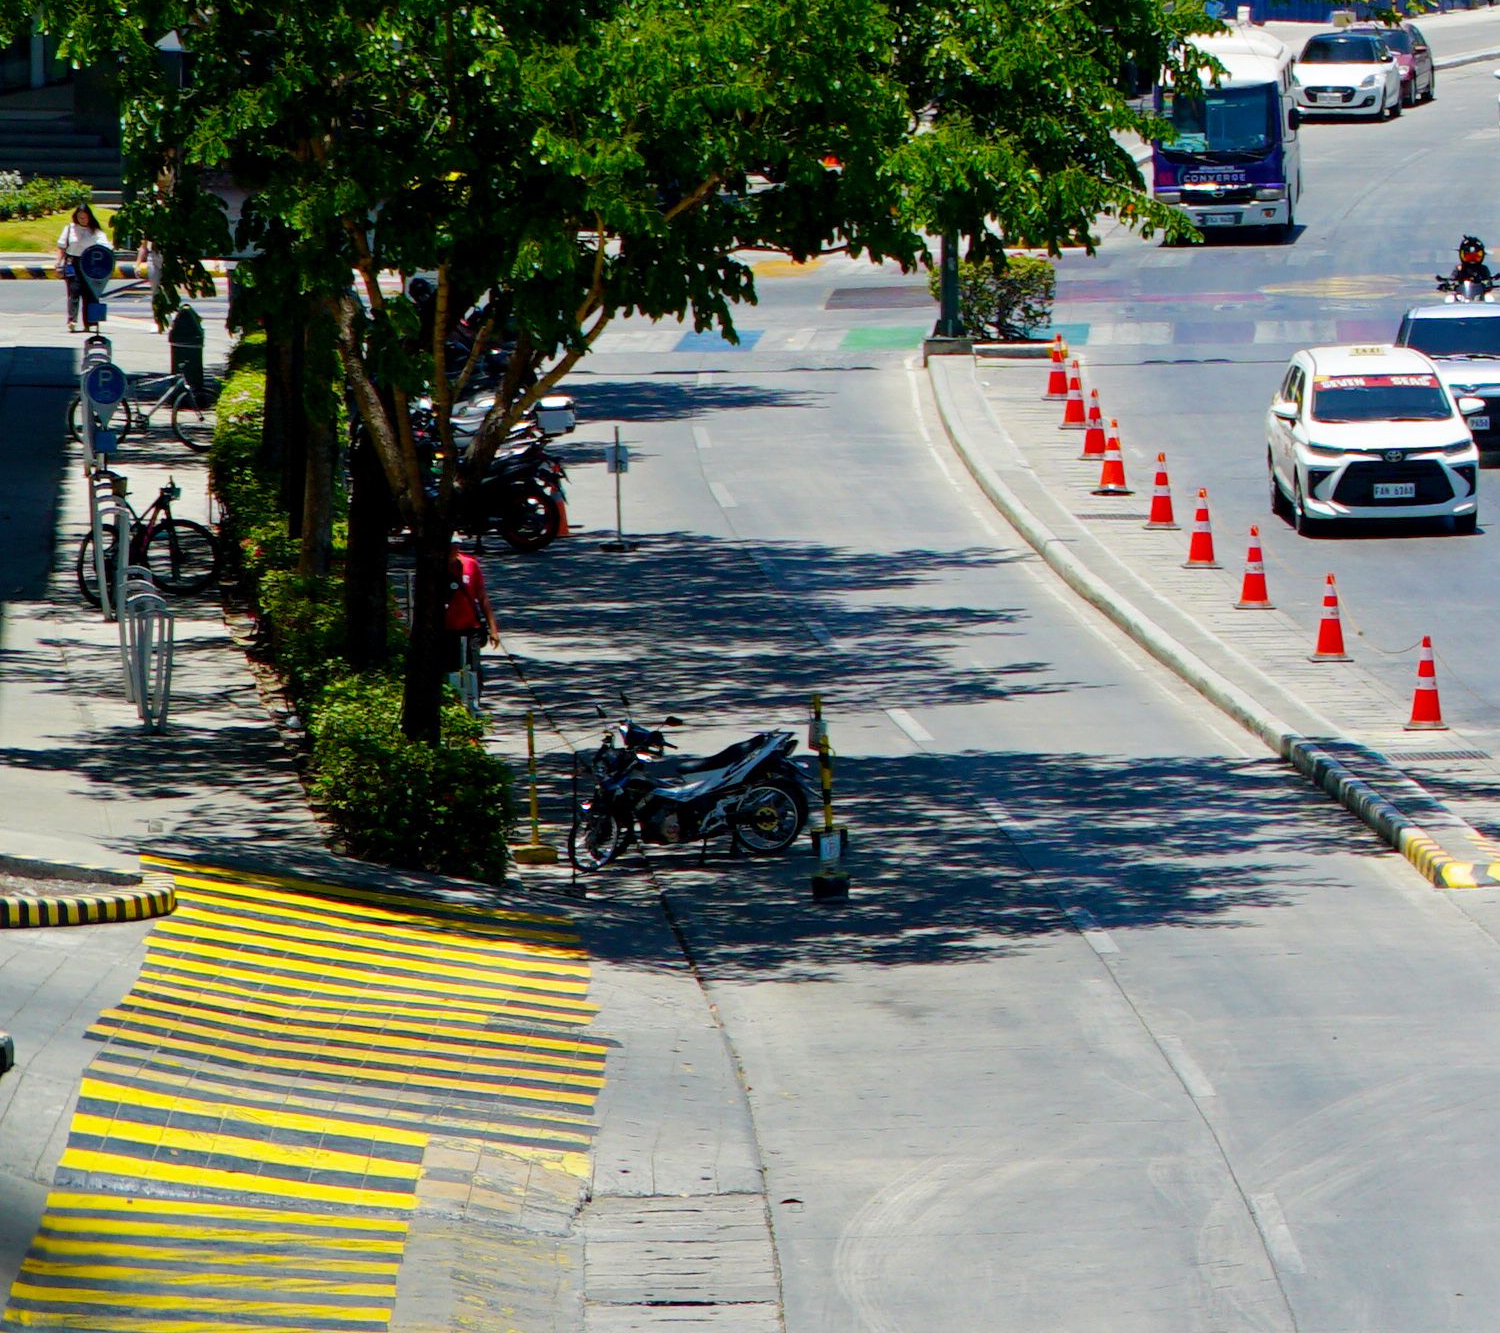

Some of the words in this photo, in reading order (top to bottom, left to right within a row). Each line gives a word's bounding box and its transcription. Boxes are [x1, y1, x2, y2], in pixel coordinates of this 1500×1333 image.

[1183, 173, 1246, 182] CONVERGE
[91, 251, 103, 265] P
[98, 370, 113, 387] P
